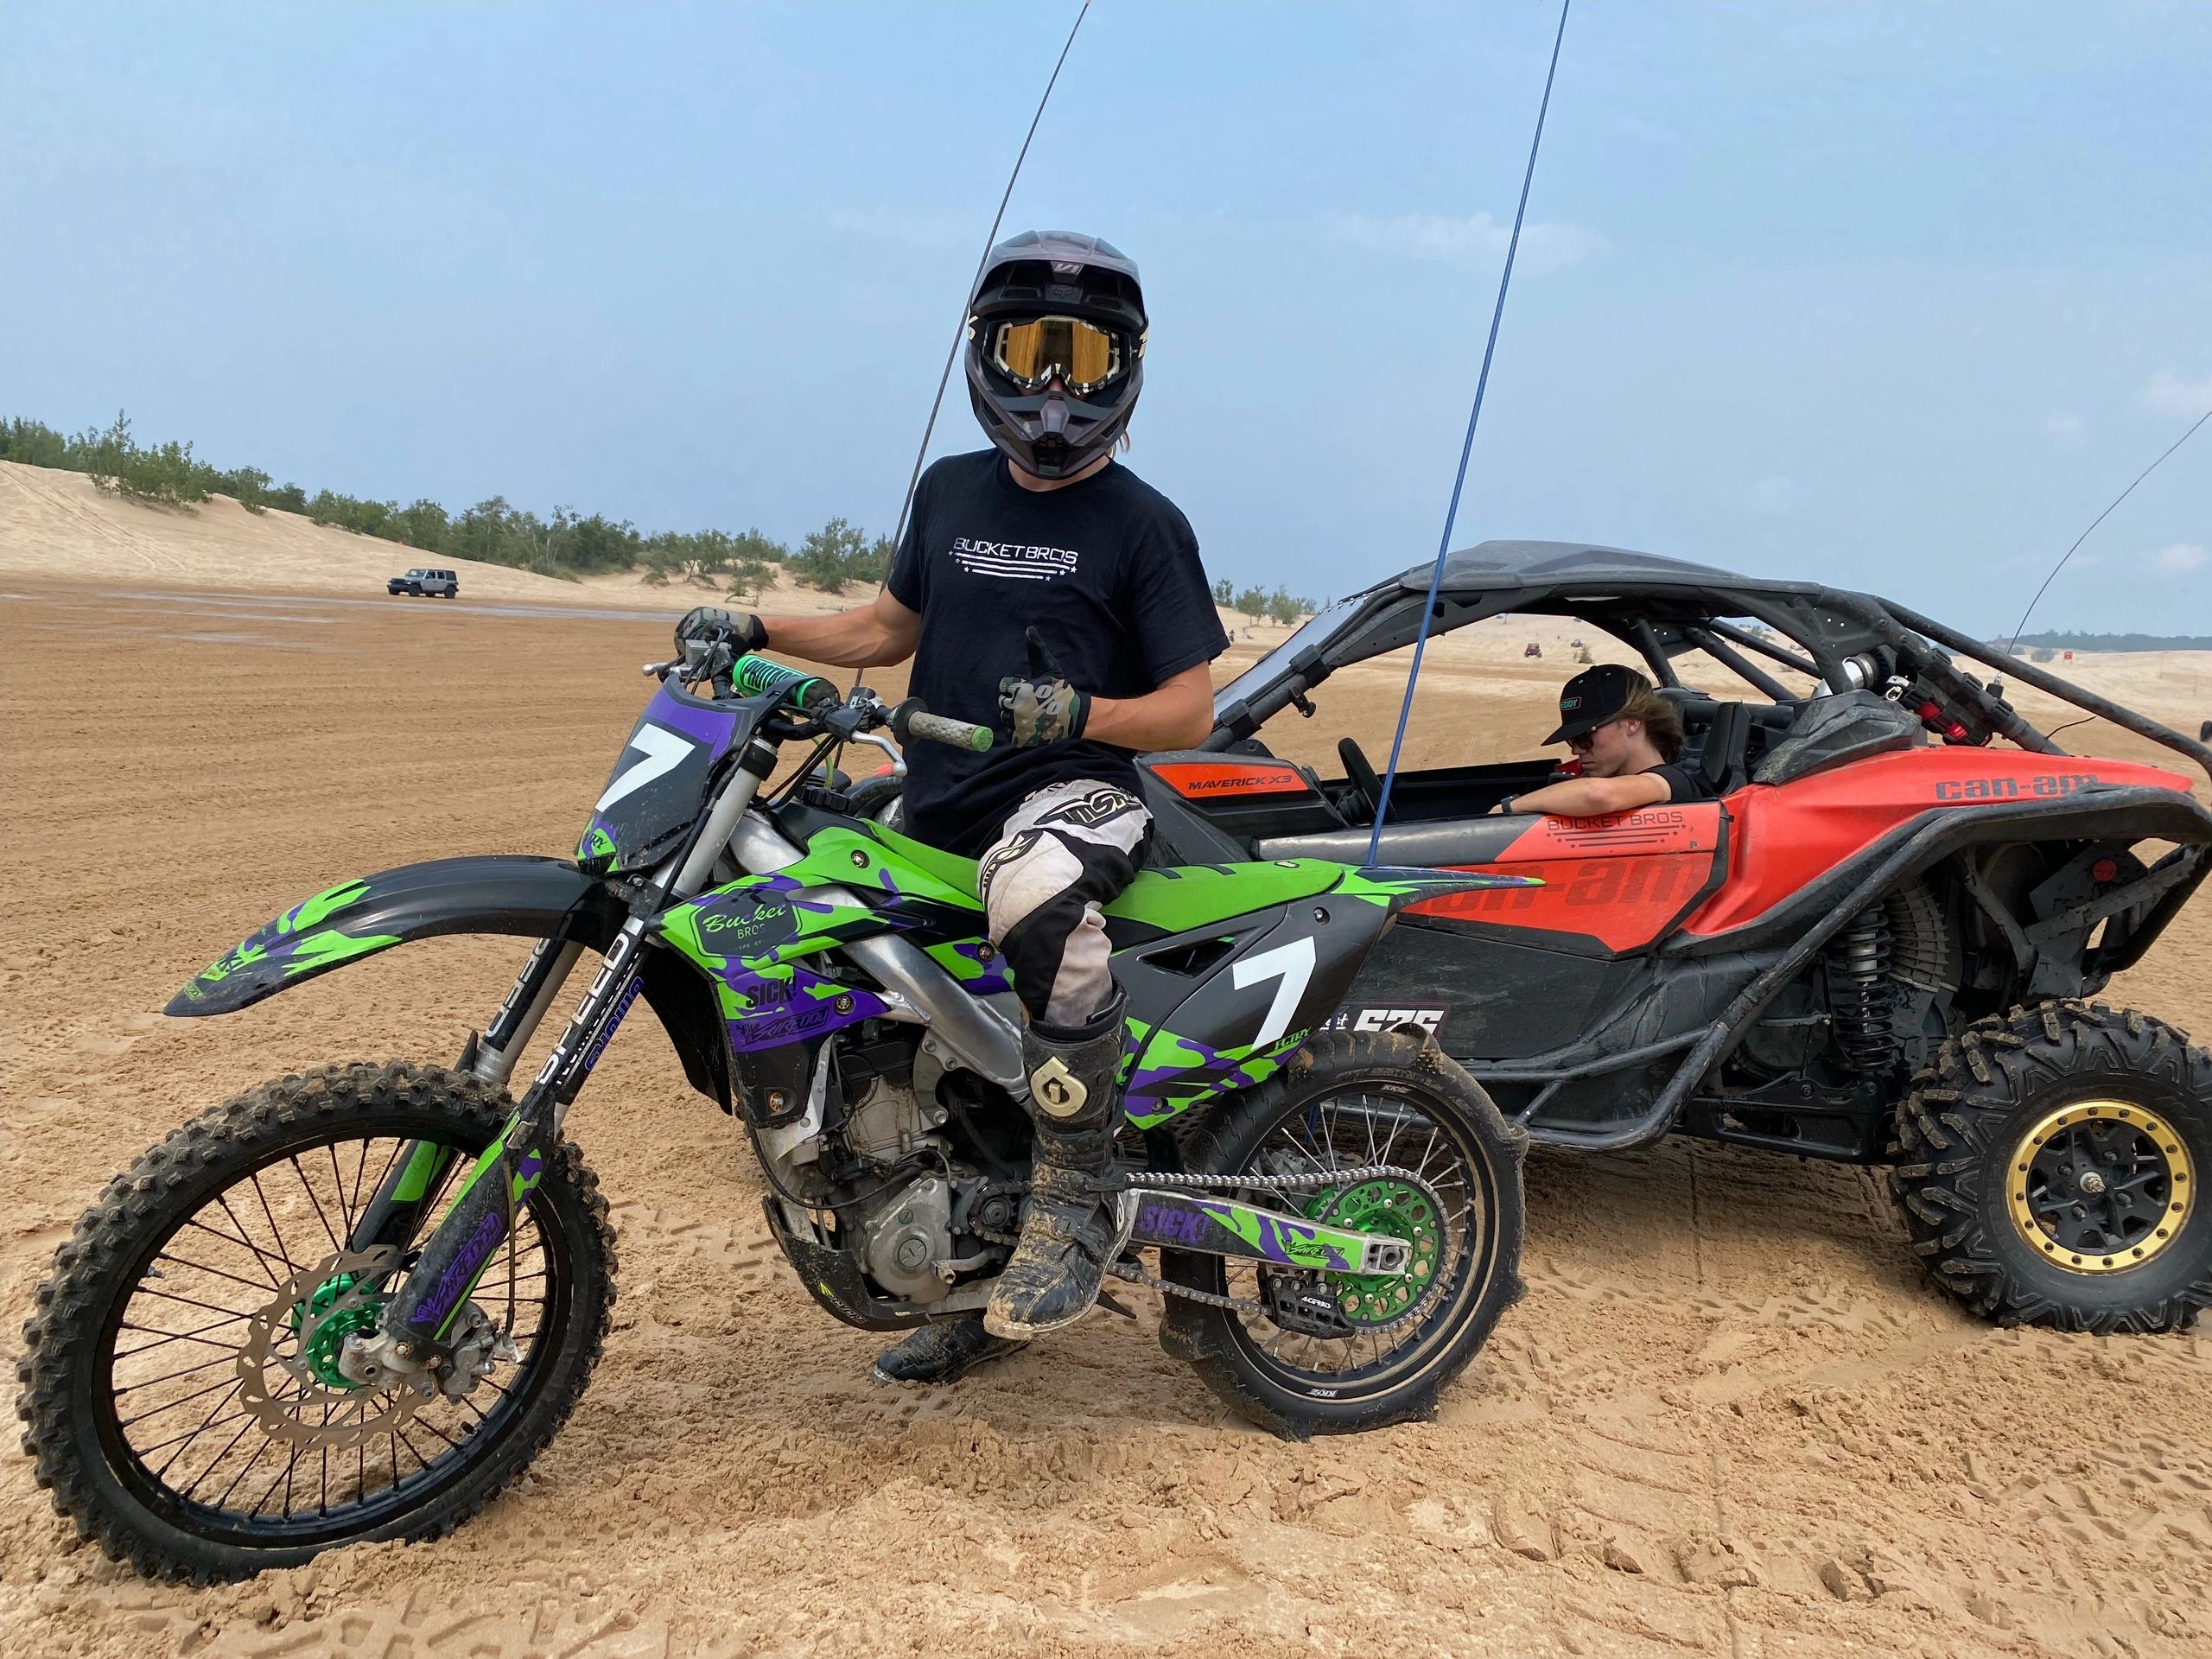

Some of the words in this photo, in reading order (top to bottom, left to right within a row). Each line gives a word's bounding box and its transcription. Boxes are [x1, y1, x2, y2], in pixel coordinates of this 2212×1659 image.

[953, 537, 1026, 558] BUCKET
[1025, 546, 1078, 564] BROS
[594, 722, 696, 813] 7
[1188, 777, 1266, 790] MAVERICK
[1268, 774, 1293, 785] X3
[1935, 774, 2100, 800] can-am
[1548, 816, 1623, 831] BUCKET
[1630, 811, 1683, 827] BROS
[737, 923, 766, 940] BROS
[745, 976, 797, 1008] SICK!
[1232, 935, 1317, 1051] 7
[534, 932, 630, 1085] SPEED
